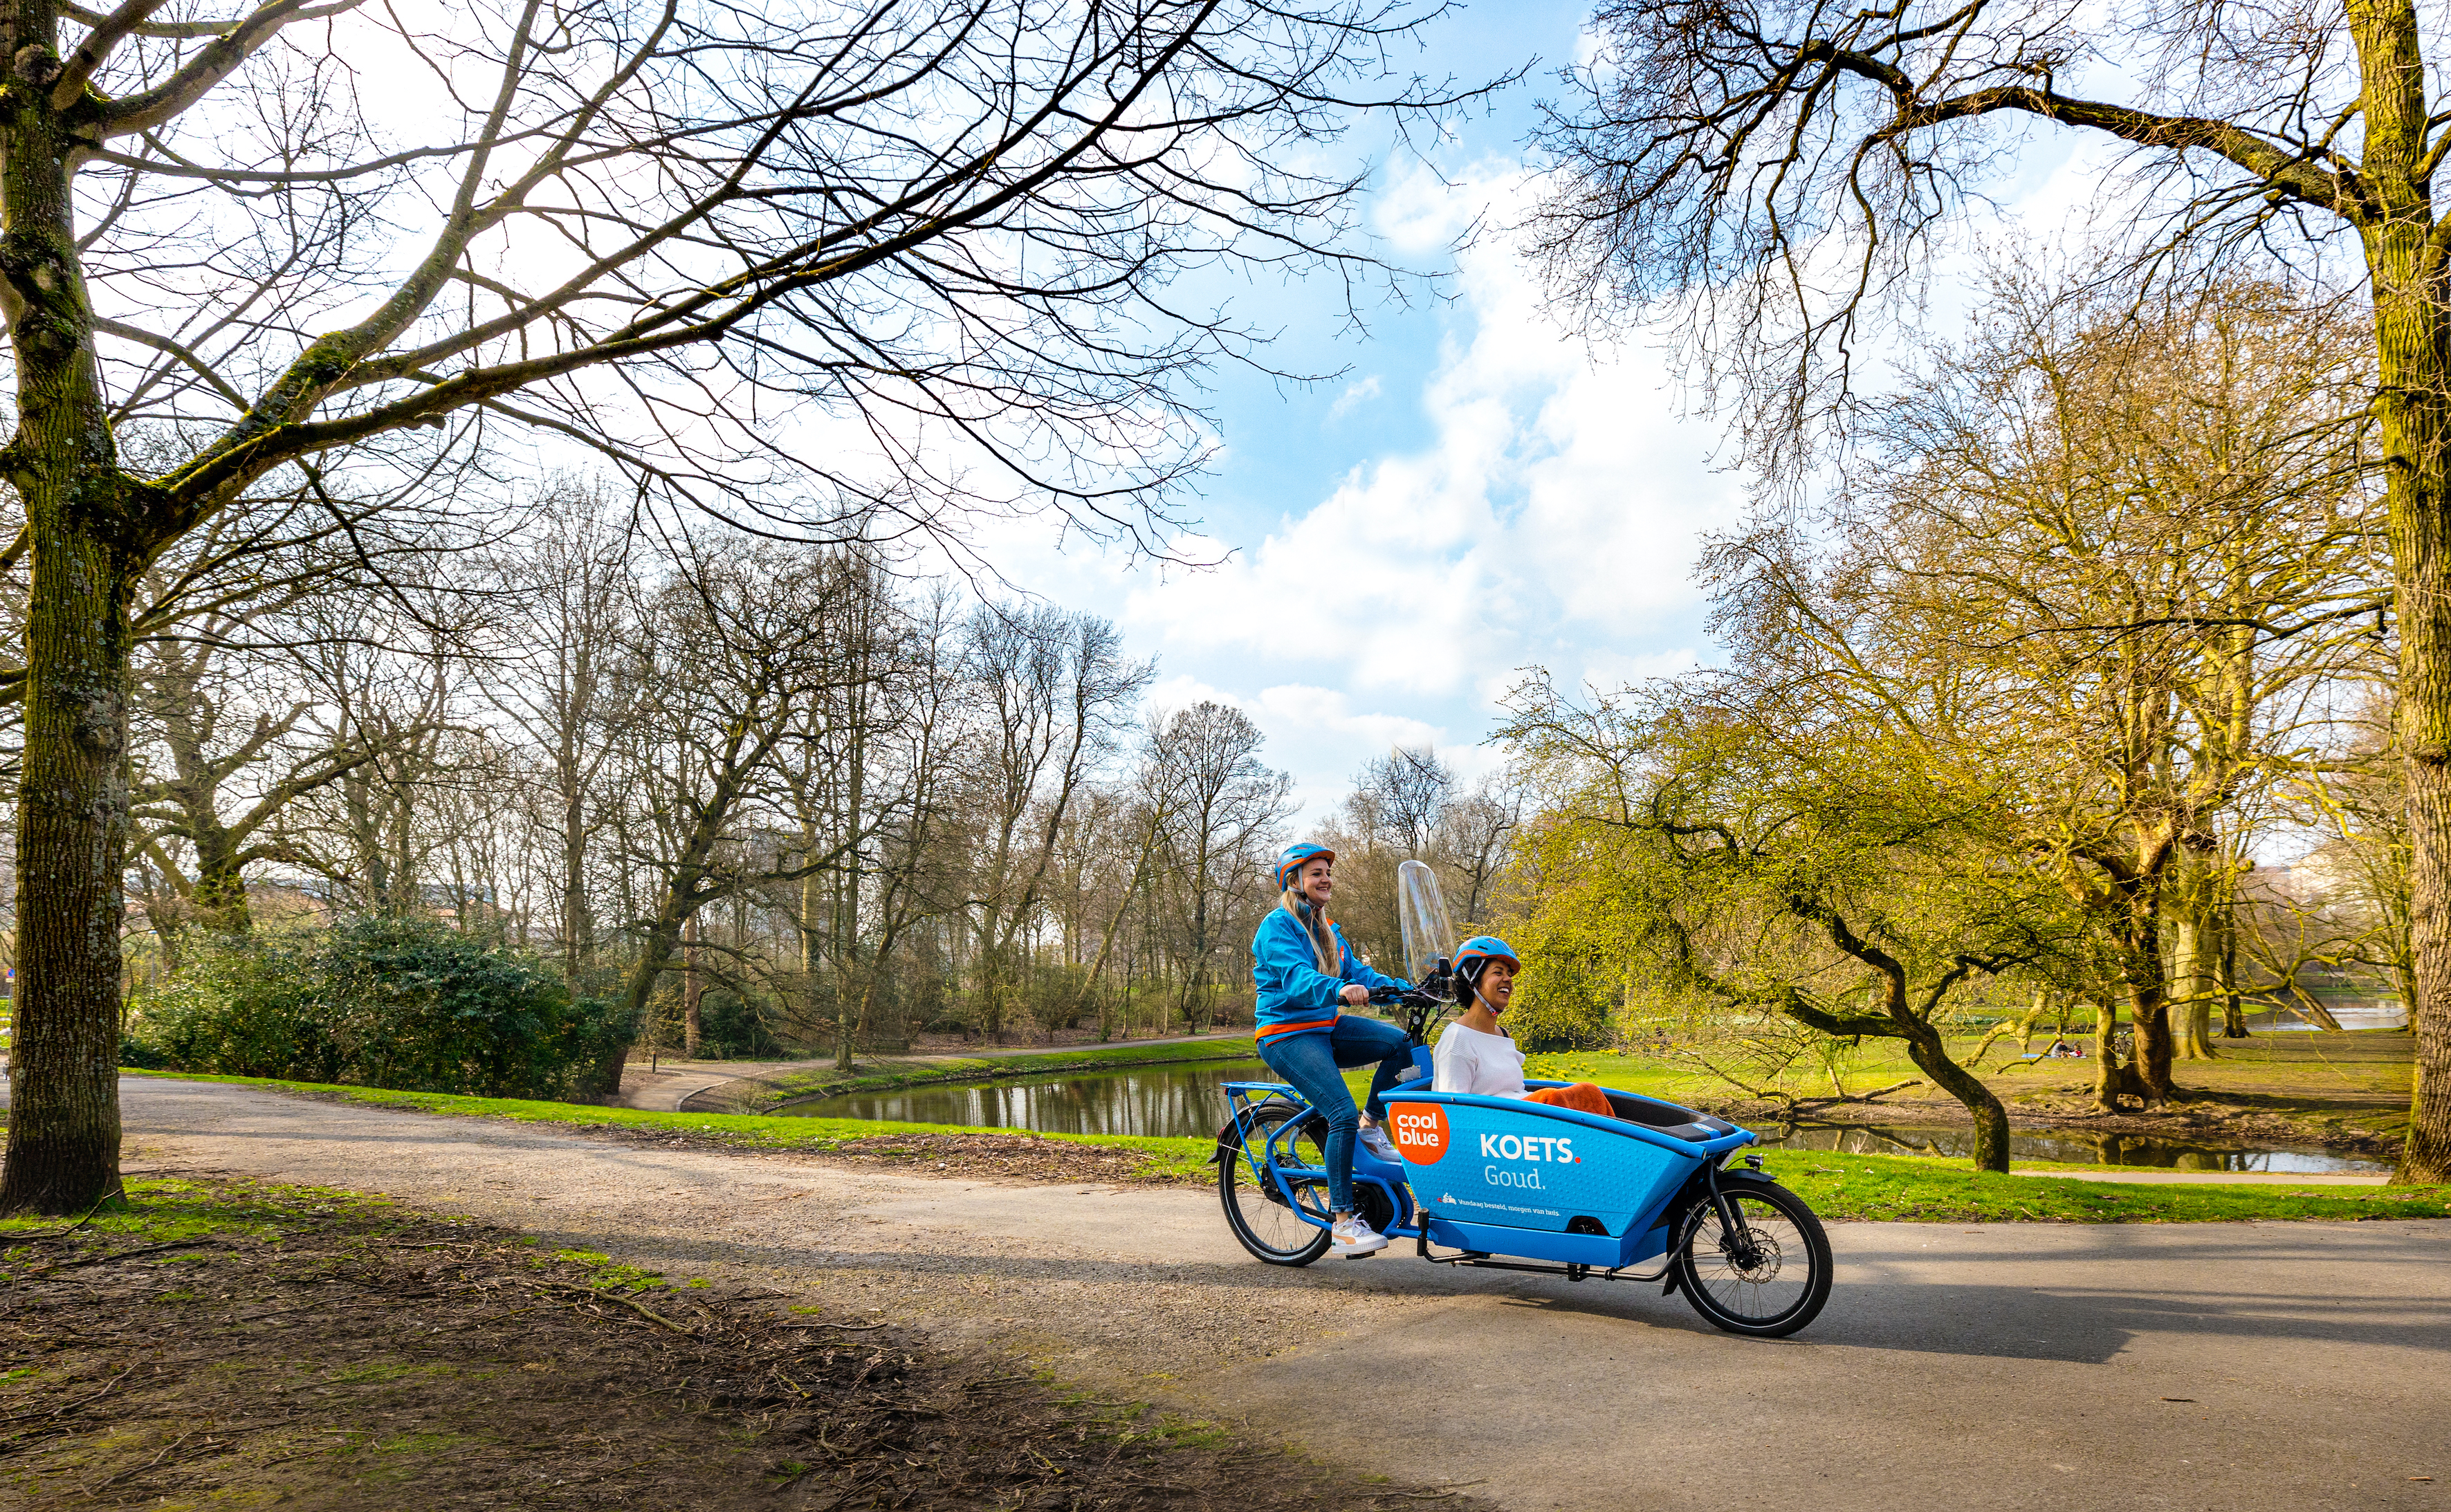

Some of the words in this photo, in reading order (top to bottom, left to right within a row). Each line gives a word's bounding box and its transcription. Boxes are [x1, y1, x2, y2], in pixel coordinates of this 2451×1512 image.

[1397, 1112, 1438, 1130] cool
[1398, 1127, 1440, 1147] blue
[1480, 1133, 1581, 1164] KOETS.
[1485, 1165, 1546, 1190] Goud.
[1458, 1199, 1484, 1208] Vandaag
[1484, 1201, 1507, 1210] besteld,
[1508, 1206, 1532, 1214] morgen
[1545, 1208, 1561, 1217] huis.
